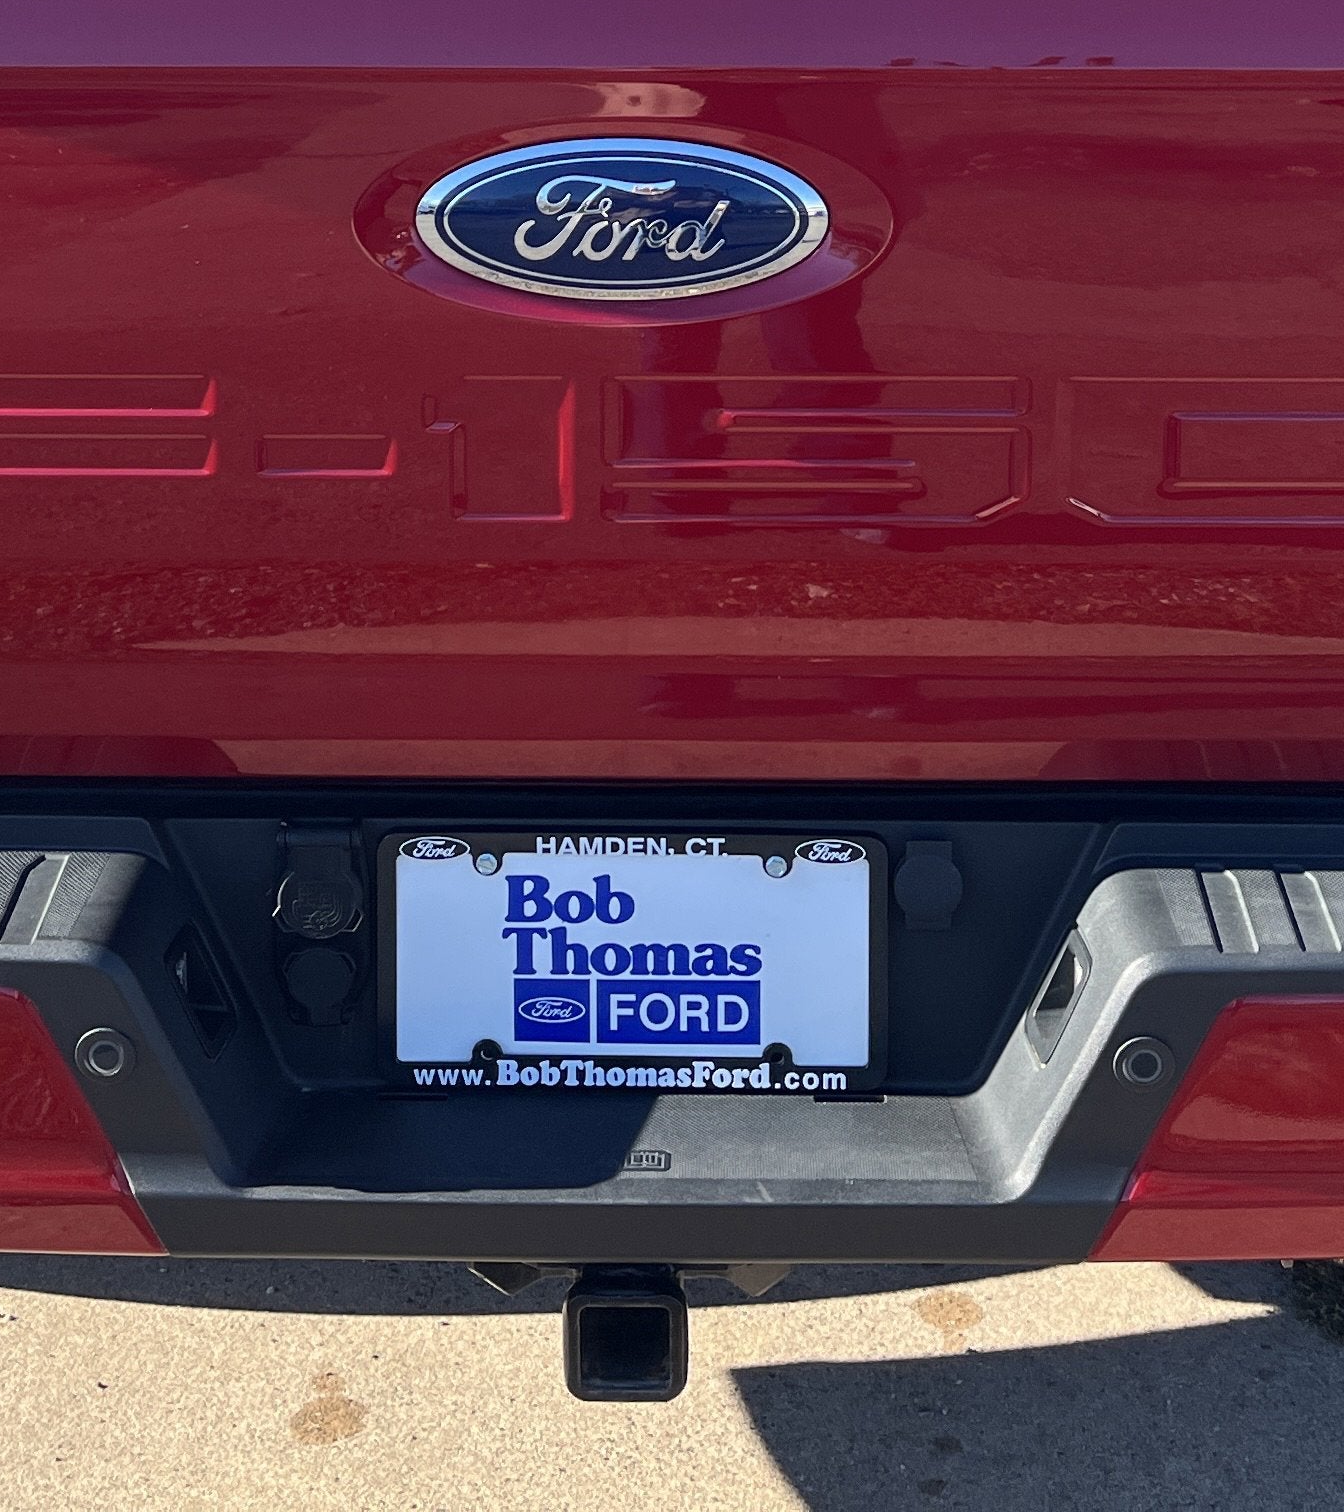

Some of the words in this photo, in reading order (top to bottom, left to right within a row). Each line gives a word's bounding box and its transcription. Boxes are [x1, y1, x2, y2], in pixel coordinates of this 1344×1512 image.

[514, 175, 731, 261] Ford
[412, 839, 456, 859] Ford
[536, 837, 675, 857] HAMDEN,
[685, 838, 729, 857] CT.
[809, 841, 854, 863] Ford
[505, 874, 635, 924] Bob
[502, 926, 762, 977] Thomas
[530, 999, 573, 1019] Ford
[609, 993, 750, 1032] FORD
[414, 1059, 848, 1091] www.BobThomasFord.com
